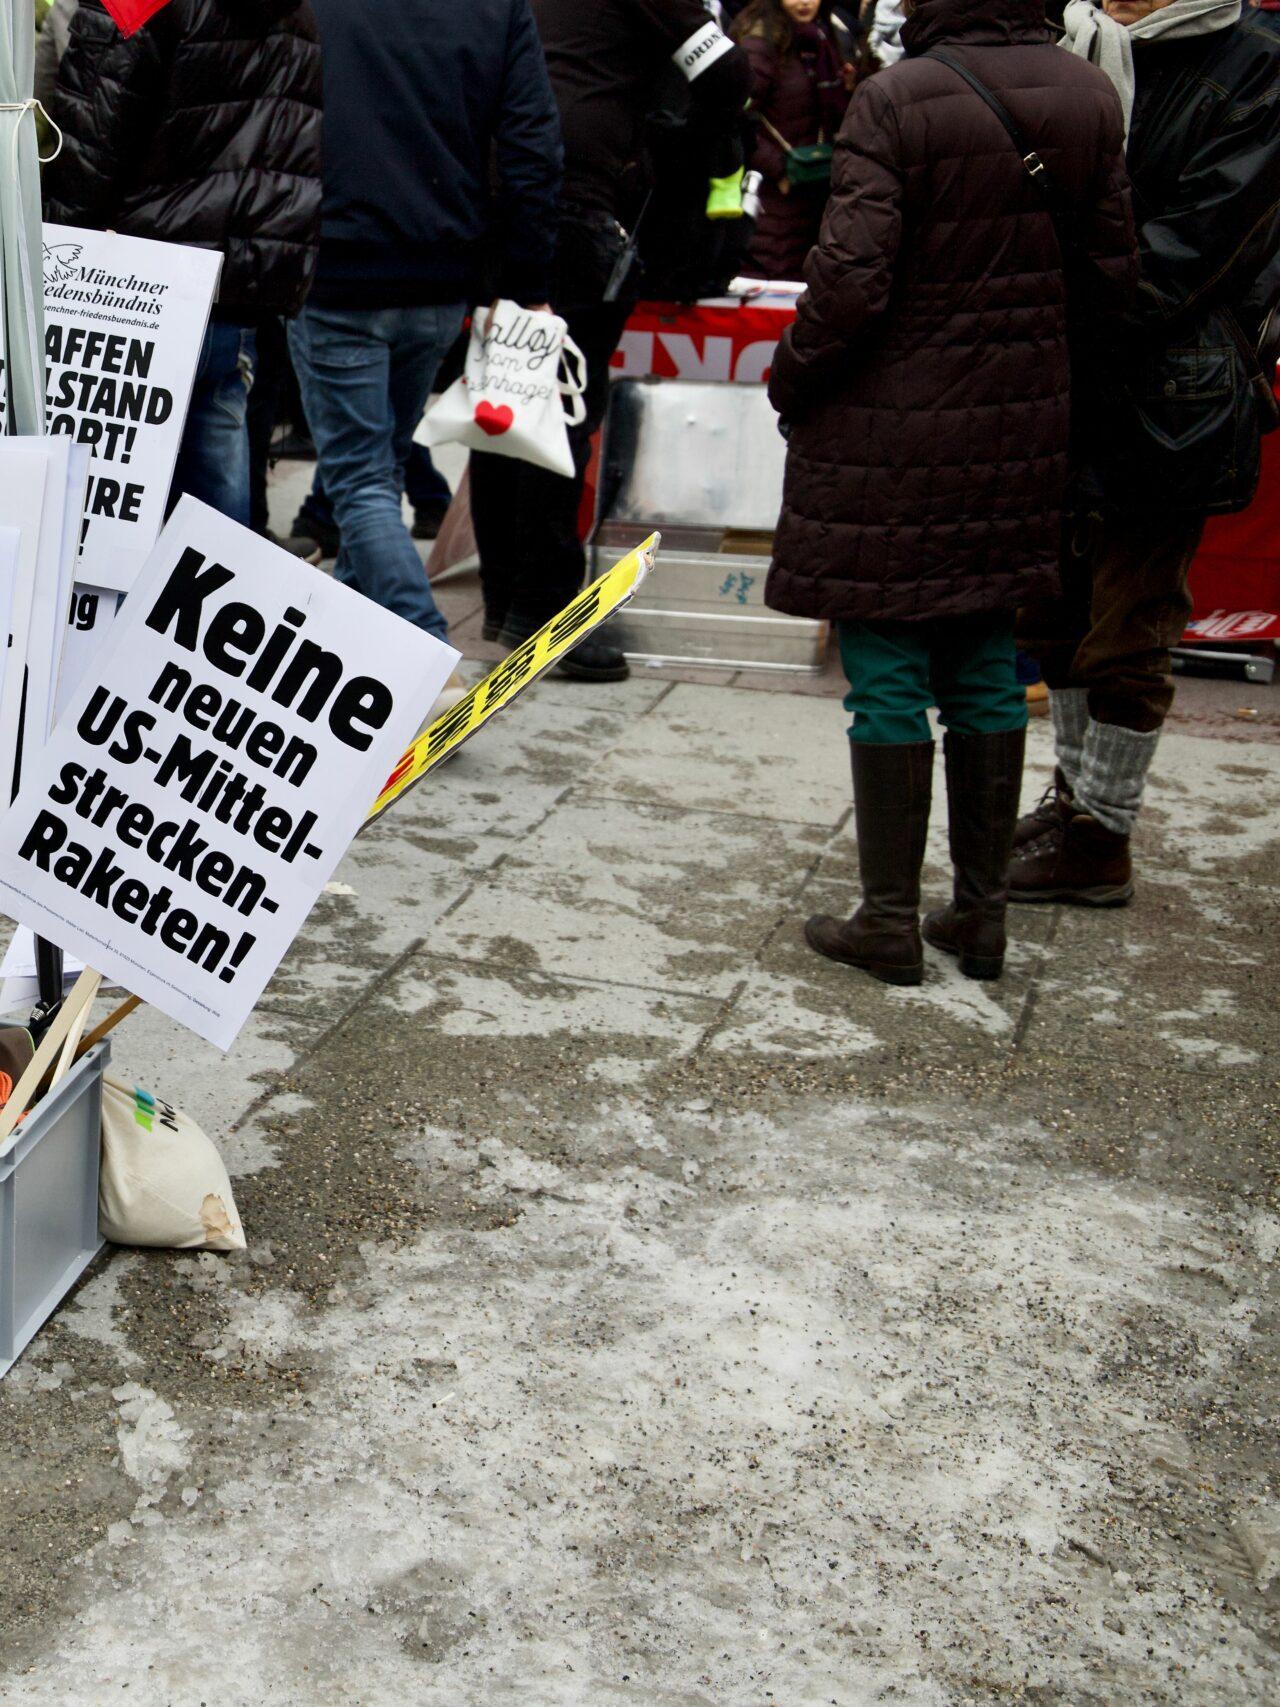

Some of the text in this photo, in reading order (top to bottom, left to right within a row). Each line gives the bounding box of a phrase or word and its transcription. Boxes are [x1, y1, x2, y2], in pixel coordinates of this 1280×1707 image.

[43, 280, 163, 316] edensbündnis
[45, 324, 155, 379] AFFEN
[75, 266, 169, 296] Münchner
[145, 546, 394, 752] Keine
[76, 685, 323, 864] US-Mittel-
[148, 661, 318, 788] neuen
[18, 809, 257, 984] Raketen!
[48, 761, 280, 917] strecken-
